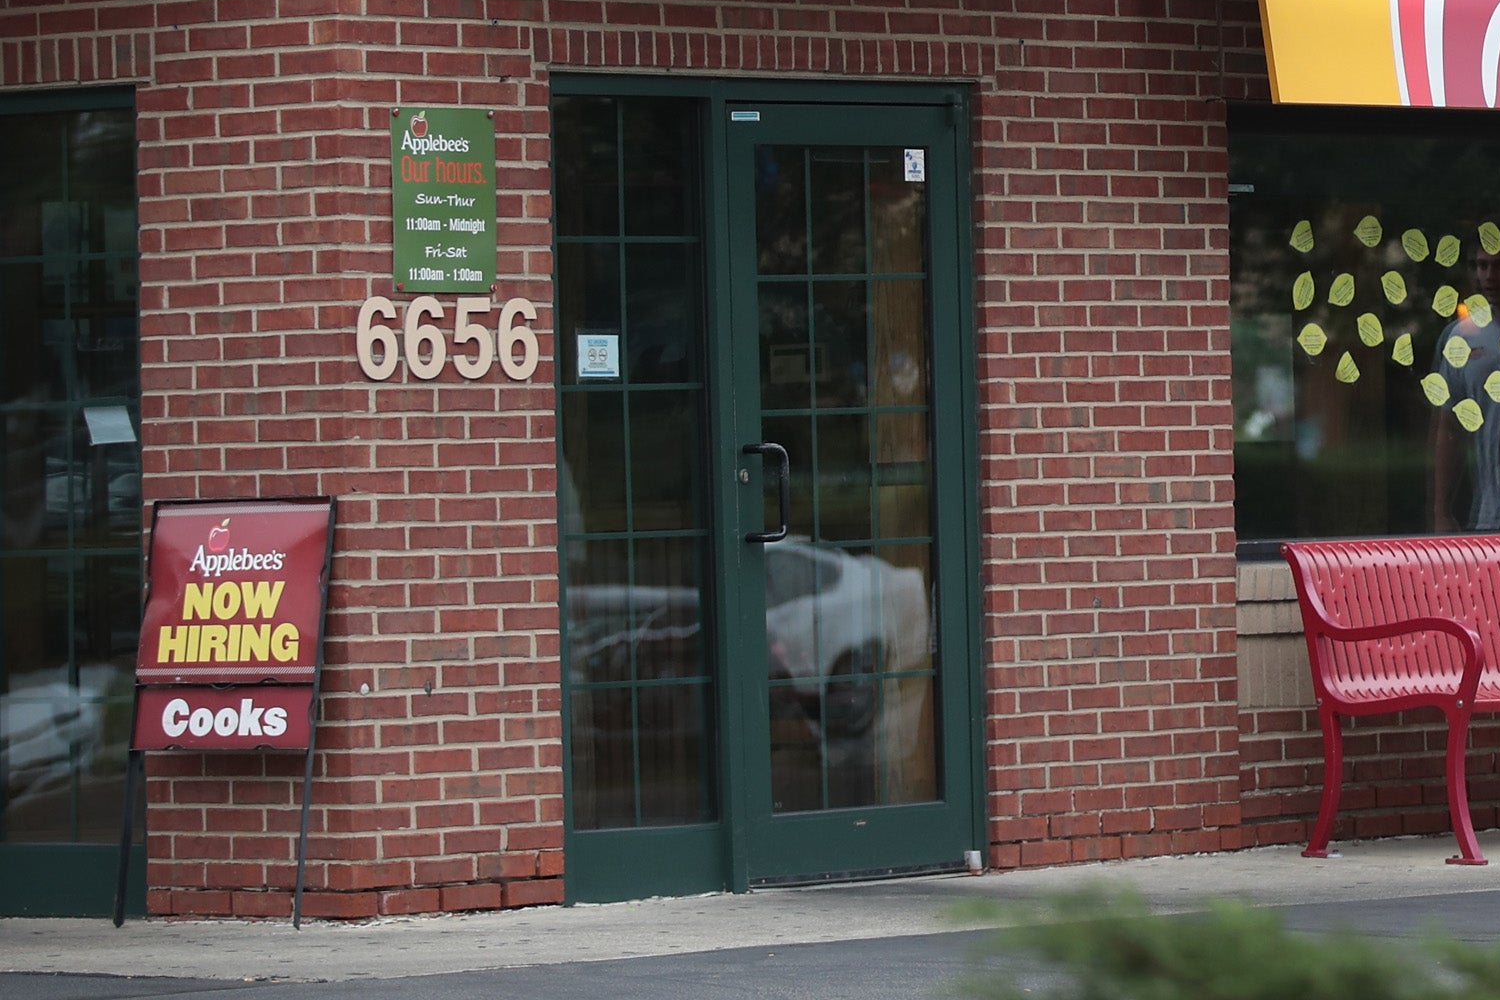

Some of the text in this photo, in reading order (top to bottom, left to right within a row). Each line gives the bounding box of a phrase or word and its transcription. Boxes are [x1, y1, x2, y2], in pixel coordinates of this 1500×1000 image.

[401, 130, 469, 155] Applebee's
[401, 155, 487, 184] Our hours.
[415, 193, 476, 207] Sun-Thur
[406, 217, 441, 231] 11:00am
[449, 218, 485, 234] Midnight
[425, 243, 468, 258] Fri-Sat
[409, 267, 444, 281] 11:00am
[453, 268, 483, 282] 1:00am
[356, 296, 540, 381] 6656
[189, 545, 285, 577] Applebee's
[182, 580, 285, 620] NOW
[157, 622, 299, 663] HIRING
[161, 698, 288, 737] Cooks
